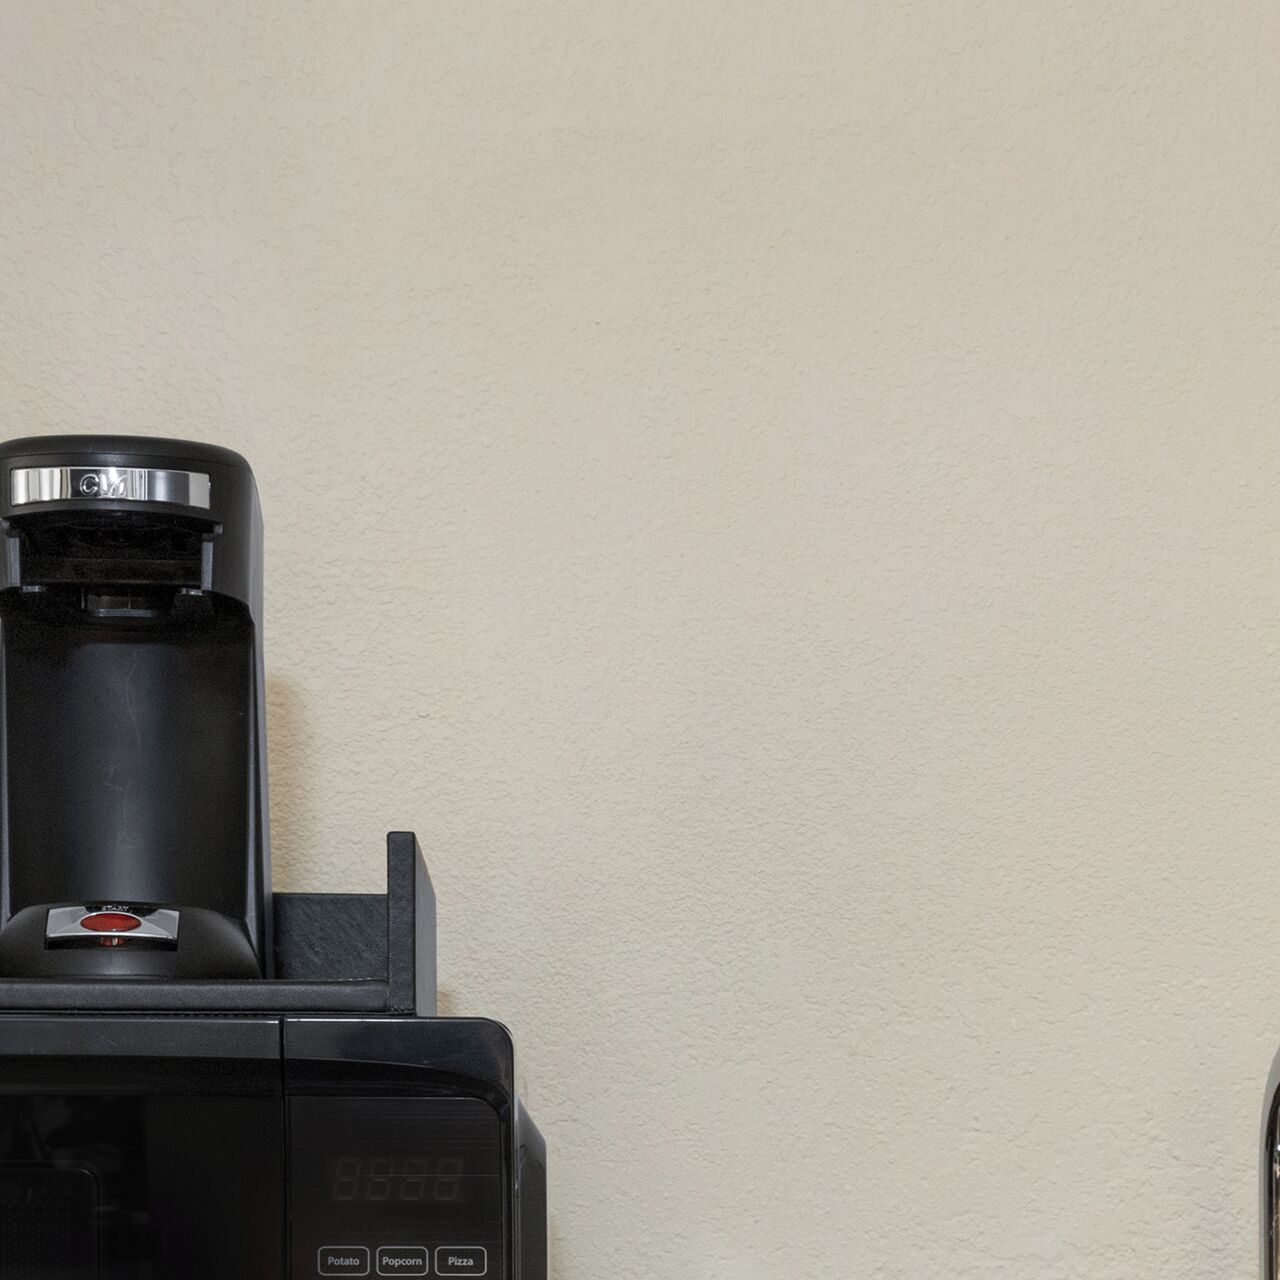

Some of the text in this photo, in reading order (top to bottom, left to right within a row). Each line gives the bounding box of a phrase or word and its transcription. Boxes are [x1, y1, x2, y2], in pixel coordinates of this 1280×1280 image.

[327, 1256, 360, 1266] Potato
[382, 1256, 423, 1268] Popcorn
[448, 1256, 474, 1266] Pizza
